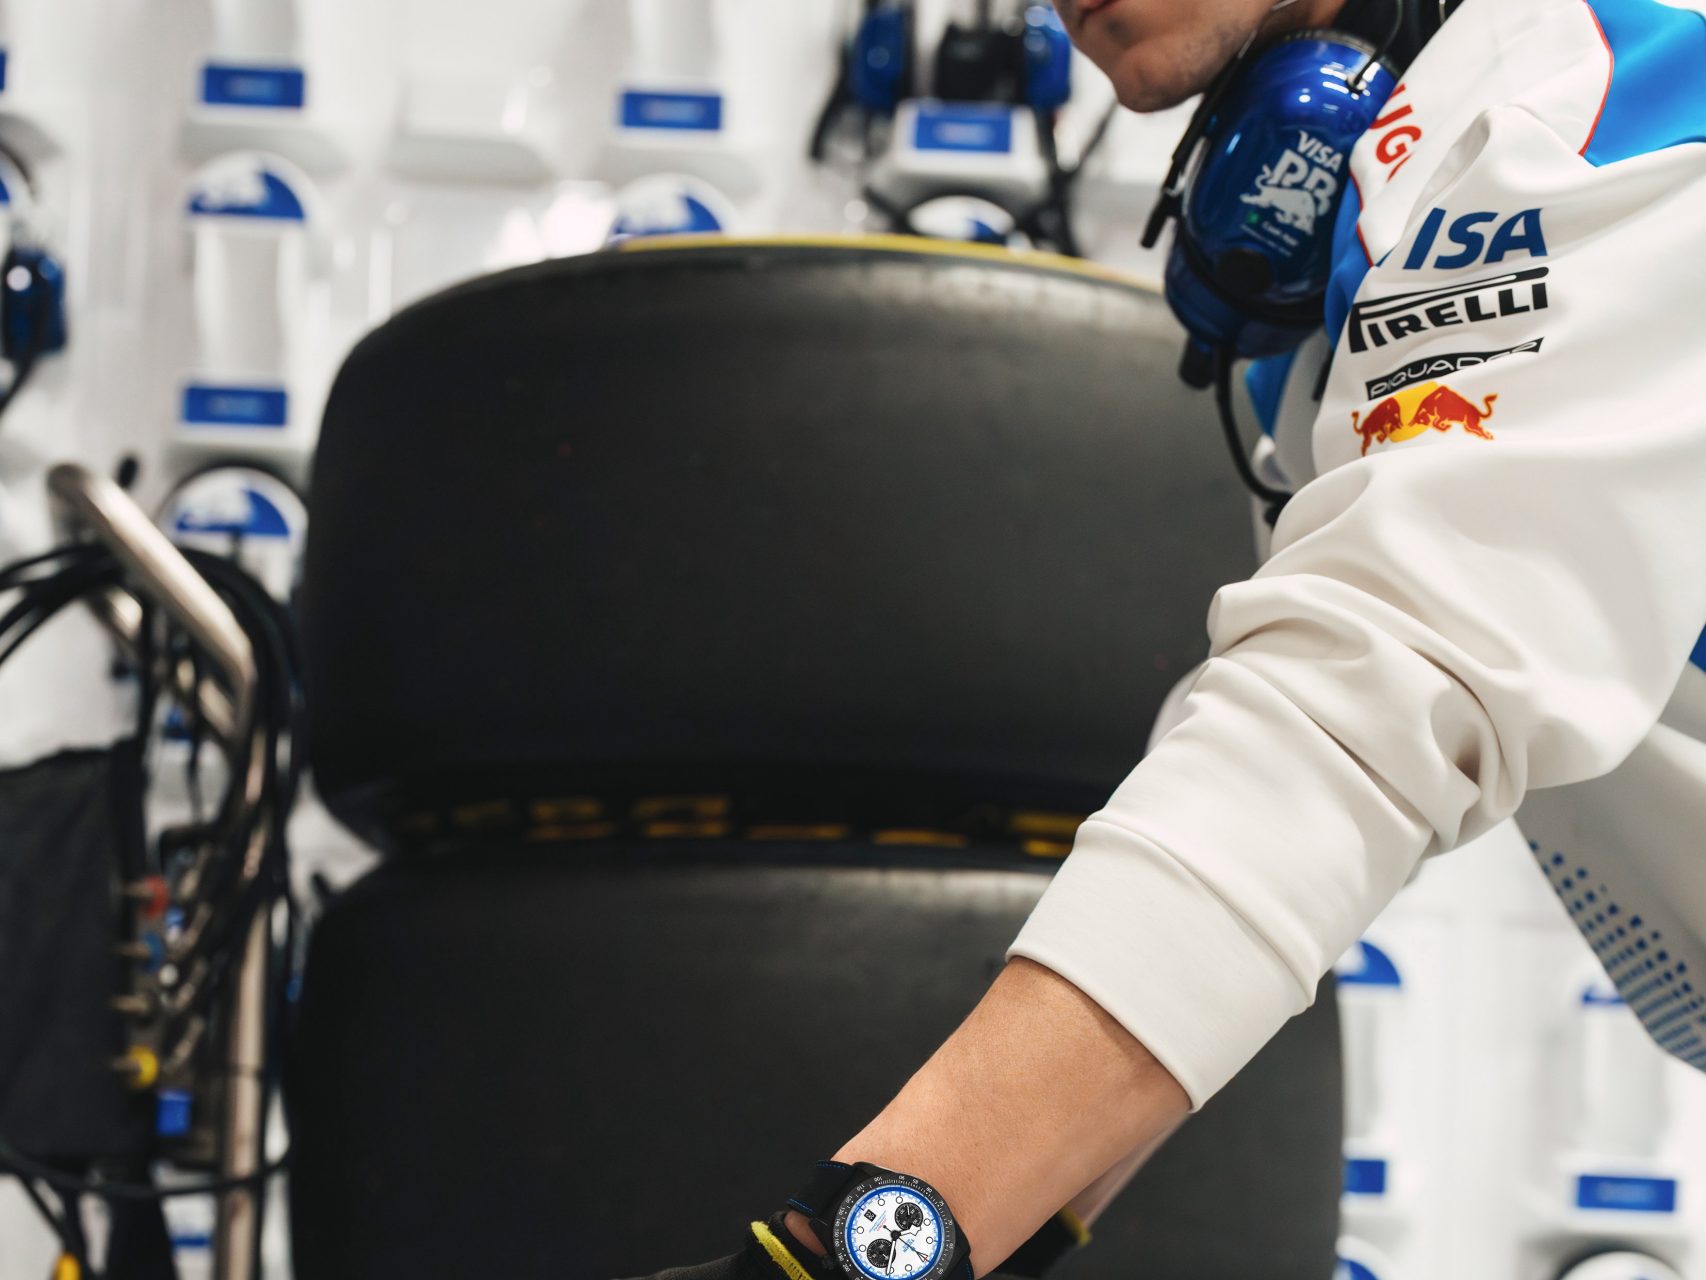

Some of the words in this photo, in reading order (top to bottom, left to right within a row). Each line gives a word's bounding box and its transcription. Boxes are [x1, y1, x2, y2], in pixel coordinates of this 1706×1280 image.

[1298, 130, 1343, 173] VISA
[1375, 207, 1548, 270] ISA
[1349, 267, 1549, 353] PIRELLI
